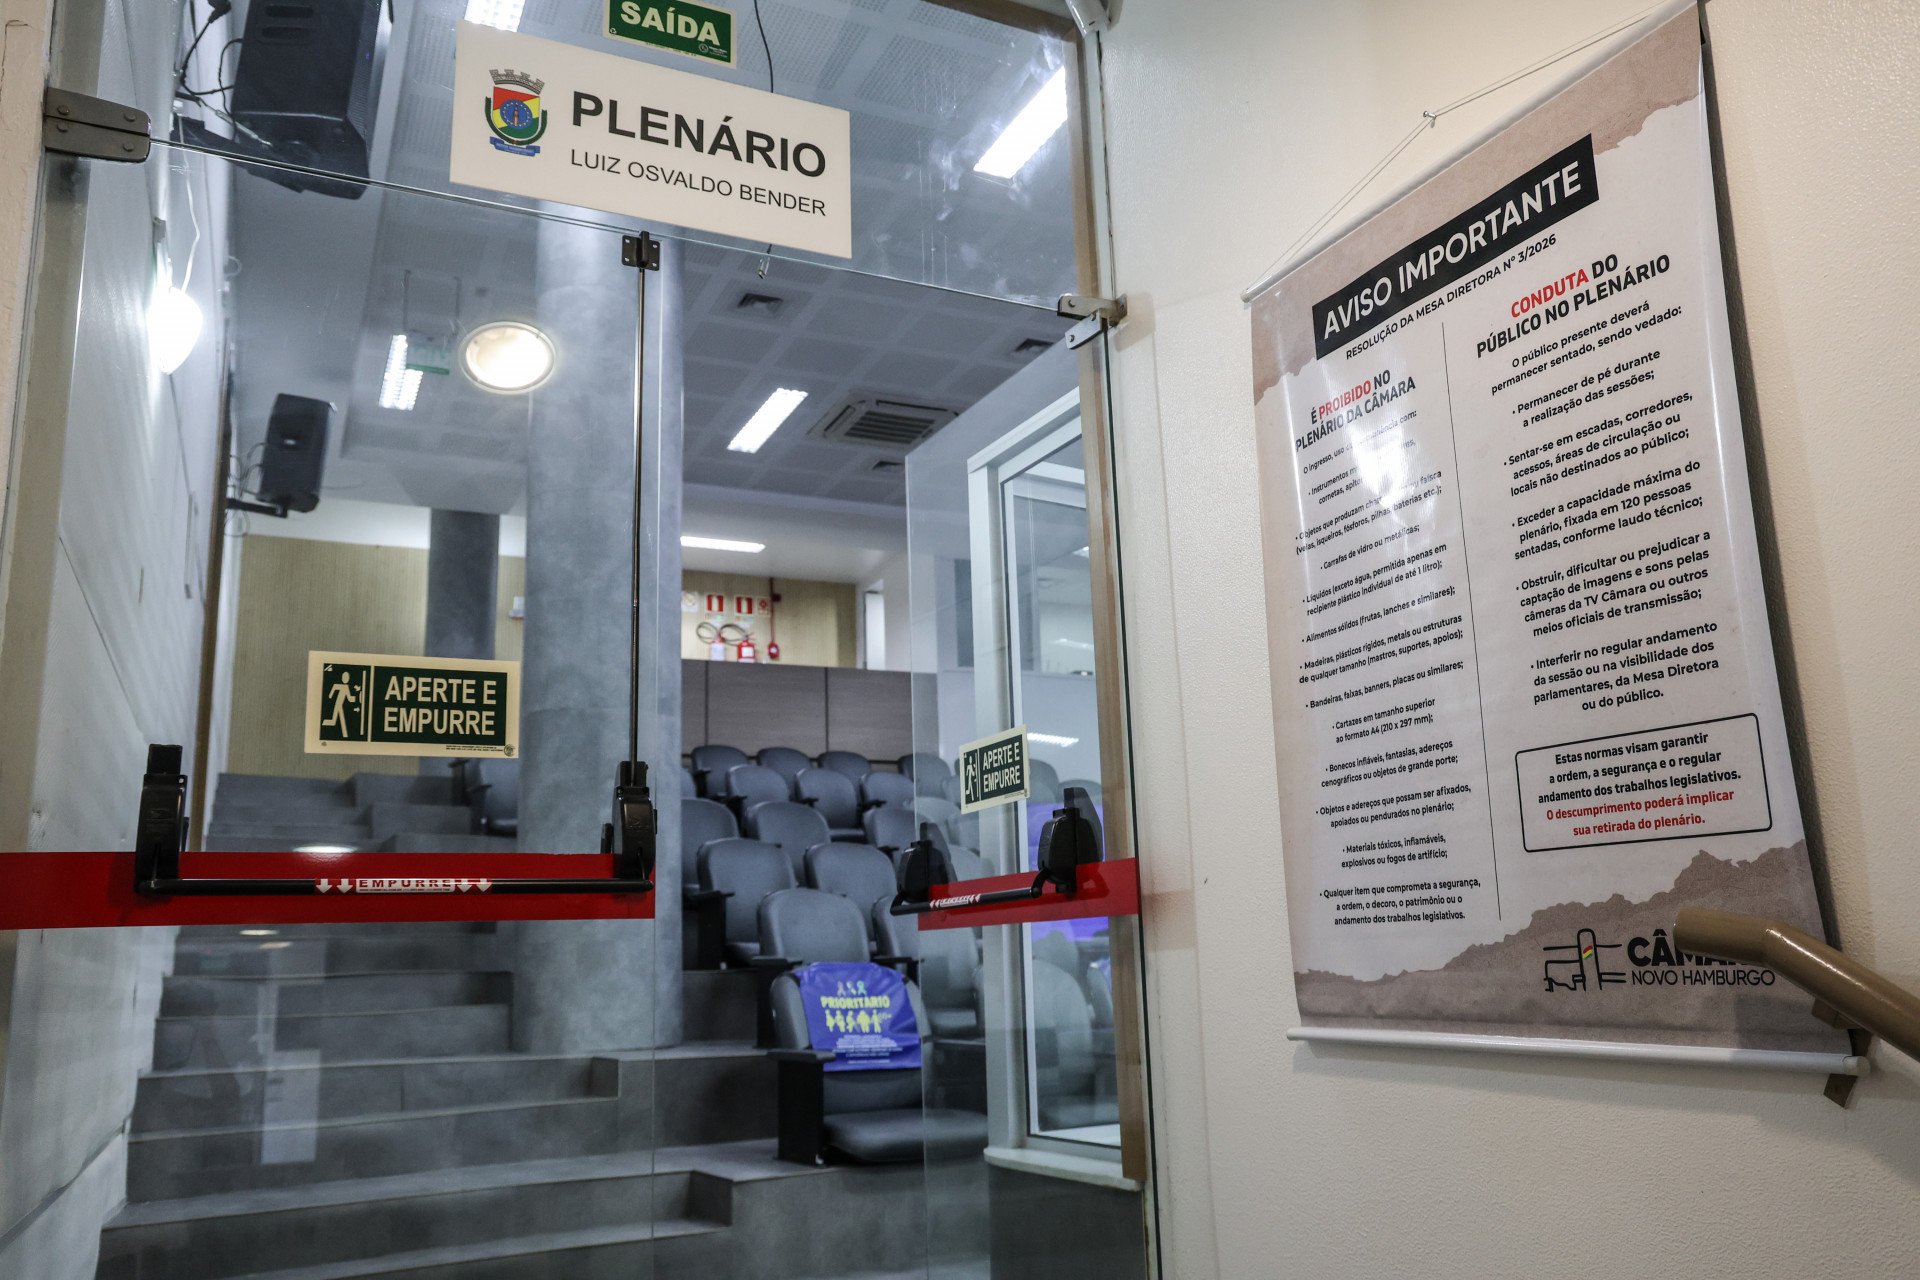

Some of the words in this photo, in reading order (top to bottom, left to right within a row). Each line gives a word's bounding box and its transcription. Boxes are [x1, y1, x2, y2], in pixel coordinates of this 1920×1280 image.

[620, 1, 721, 46] SAÍDA
[572, 91, 826, 177] PLENÁRIO
[572, 149, 620, 175] LUIZ
[628, 161, 732, 196] OSVALDO
[740, 186, 825, 216] BENDER
[1323, 277, 1392, 340] AVISO
[1398, 161, 1582, 293] IMPORTANTE
[1346, 322, 1398, 360] RESOLUÇÃO
[1400, 313, 1414, 328] DA
[1416, 297, 1444, 319] MESA
[1446, 266, 1501, 302] DIRETORA
[1517, 233, 1556, 263] 3/2026
[1476, 313, 1541, 358] PÚBLICO
[1545, 299, 1569, 324] NO
[1573, 254, 1670, 311] PLENÁRIO
[1511, 268, 1589, 317] CONDUTA
[1591, 253, 1618, 279] DO
[1491, 362, 1547, 396] permanecer
[1550, 343, 1595, 367] sentado,
[1597, 327, 1632, 347] sendo
[1634, 305, 1681, 331] vedado:
[1511, 358, 1519, 367] O
[1521, 342, 1558, 366] público
[1560, 320, 1607, 348] presente
[1610, 300, 1649, 324] deverá
[1310, 409, 1317, 424] É
[1318, 380, 1371, 419] PROIBIDO
[1373, 369, 1390, 390] NO
[1517, 382, 1578, 413] Permanecer
[1580, 376, 1594, 387] de
[1597, 367, 1611, 383] pé
[1613, 350, 1660, 374] durante
[1523, 419, 1528, 427] a
[1530, 398, 1582, 424] realização
[1584, 389, 1604, 402] das
[1606, 370, 1654, 394] sessões;
[1295, 415, 1343, 452] PLENÁRIO
[1346, 404, 1363, 423] DA
[1364, 376, 1416, 413] CÂMARA
[1508, 441, 1553, 465] Sentar-se
[1556, 434, 1573, 446] em
[1575, 417, 1622, 439] escadas,
[1625, 392, 1692, 421] corredores,
[1510, 479, 1537, 496] locais
[1539, 473, 1558, 486] não
[1560, 451, 1621, 478] destinados
[1623, 446, 1638, 457] ao
[1641, 428, 1688, 454] público;
[1513, 459, 1553, 479] acessos,
[1555, 447, 1583, 463] áreas
[1585, 441, 1600, 452] de
[1602, 420, 1662, 446] circulação
[1664, 413, 1680, 425] ou
[1517, 506, 1555, 526] Exceder
[1558, 504, 1564, 512] a
[1566, 482, 1630, 509] capacidade
[1633, 467, 1681, 489] máxima
[1684, 460, 1700, 472] do
[1519, 521, 1562, 544] plenário,
[1563, 510, 1597, 527] fixada
[1600, 504, 1618, 516] em
[1622, 496, 1640, 509] 120
[1643, 482, 1691, 506] pessoas
[1514, 539, 1560, 560] sentadas,
[1562, 522, 1615, 544] conforme
[1618, 511, 1651, 528] laudo
[1654, 496, 1702, 517] técnico;
[1520, 587, 1564, 606] captação
[1567, 582, 1580, 593] de
[1583, 570, 1632, 589] imagens
[1634, 567, 1642, 576] e
[1645, 559, 1673, 574] sons
[1676, 550, 1709, 568] pelas
[1521, 570, 1564, 590] Obstruir,
[1566, 556, 1616, 577] dificultar
[1619, 551, 1634, 562] ou
[1637, 533, 1699, 560] prejudicar
[1703, 531, 1710, 540] a
[1524, 604, 1566, 622] câmeras
[1568, 599, 1582, 610] da
[1585, 594, 1598, 606] TV
[1601, 584, 1646, 602] Câmara
[1649, 579, 1665, 590] ou
[1668, 569, 1708, 586] outros
[1533, 622, 1563, 636] meios
[1565, 610, 1604, 628] oficiais
[1606, 607, 1621, 618] de
[1624, 588, 1701, 614] transmissão;
[1533, 675, 1546, 686] da
[1548, 667, 1583, 683] sessão
[1585, 664, 1600, 675] ou
[1602, 661, 1617, 671] na
[1619, 646, 1688, 668] visibilidade
[1691, 641, 1714, 654] dos
[1536, 650, 1581, 669] Interferir
[1584, 648, 1598, 658] no
[1601, 638, 1642, 654] regular
[1645, 622, 1717, 645] andamento
[385, 676, 476, 704] APERTE
[483, 680, 497, 705] E
[1533, 680, 1612, 705] parlamentares,
[1615, 675, 1630, 686] da
[1632, 670, 1664, 683] Mesa
[1667, 659, 1719, 677] Diretora
[1581, 700, 1596, 710] ou
[1598, 696, 1613, 707] do
[1616, 688, 1664, 707] público.
[384, 707, 495, 736] EMPURRE
[1555, 752, 1582, 764] Estas
[1584, 746, 1623, 760] normas
[1625, 741, 1658, 754] visam
[1660, 732, 1708, 751] garantir
[982, 744, 1013, 770] APERTE
[1013, 742, 1020, 761] E
[983, 767, 1020, 792] EMPURRE
[1549, 775, 1555, 784] a
[1556, 770, 1591, 782] ordem,
[1592, 769, 1599, 777] a
[1601, 761, 1657, 777] segurança
[1659, 759, 1666, 768] e
[1668, 758, 1676, 767] o
[1678, 751, 1721, 767] regular
[1538, 788, 1592, 803] andamento
[1593, 785, 1612, 796] dos
[1614, 778, 1668, 793] trabalhos
[1669, 770, 1741, 788] legislativos.
[1546, 809, 1553, 820] O
[1555, 800, 1642, 819] descumprimento
[1644, 794, 1684, 812] poderá
[1686, 790, 1734, 806] implicar
[1573, 826, 1591, 836] sua
[1592, 819, 1635, 833] retirada
[1637, 818, 1651, 829] do
[1654, 813, 1705, 830] plenário.
[360, 879, 451, 888] EMPURRE
[1323, 888, 1353, 899] Qualquer
[1354, 886, 1370, 895] item
[1371, 886, 1385, 896] que
[1386, 882, 1431, 894] comprometa
[1438, 878, 1480, 890] segurança,
[1334, 915, 1371, 925] andamento
[1372, 914, 1386, 923] dos
[1386, 912, 1421, 922] trabalhos
[1422, 909, 1465, 922] legislativos.
[1632, 969, 1678, 986] NOVO
[1682, 969, 1775, 986] HAMBURGO
